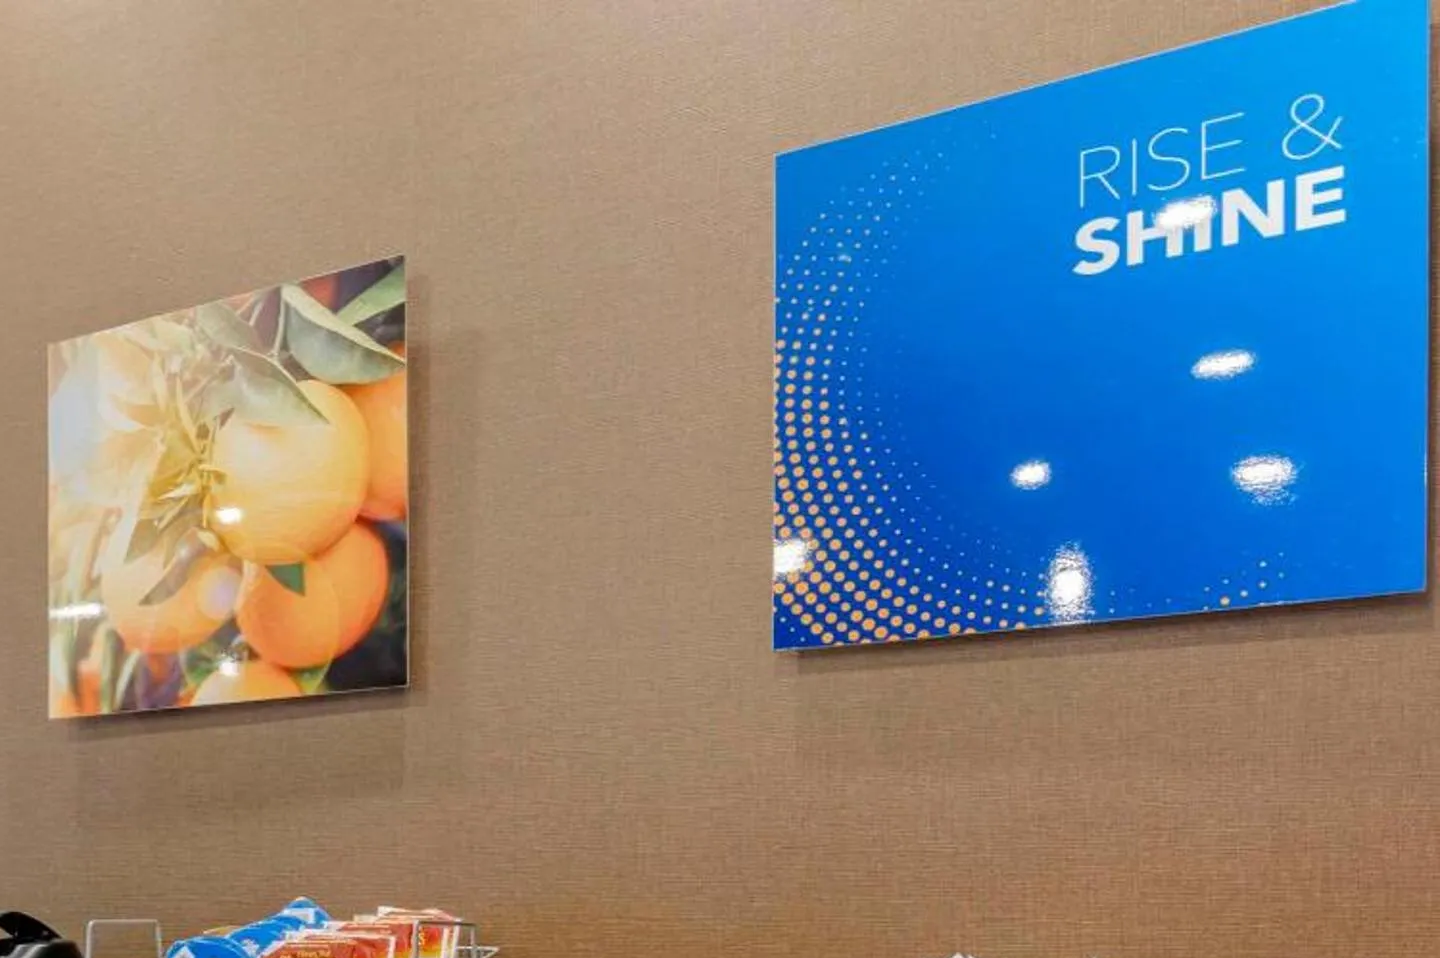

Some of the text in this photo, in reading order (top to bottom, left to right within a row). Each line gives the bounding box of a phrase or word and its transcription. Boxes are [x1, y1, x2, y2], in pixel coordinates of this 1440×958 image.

[1079, 93, 1344, 208] RISE &
[1071, 164, 1347, 276] SHINE
